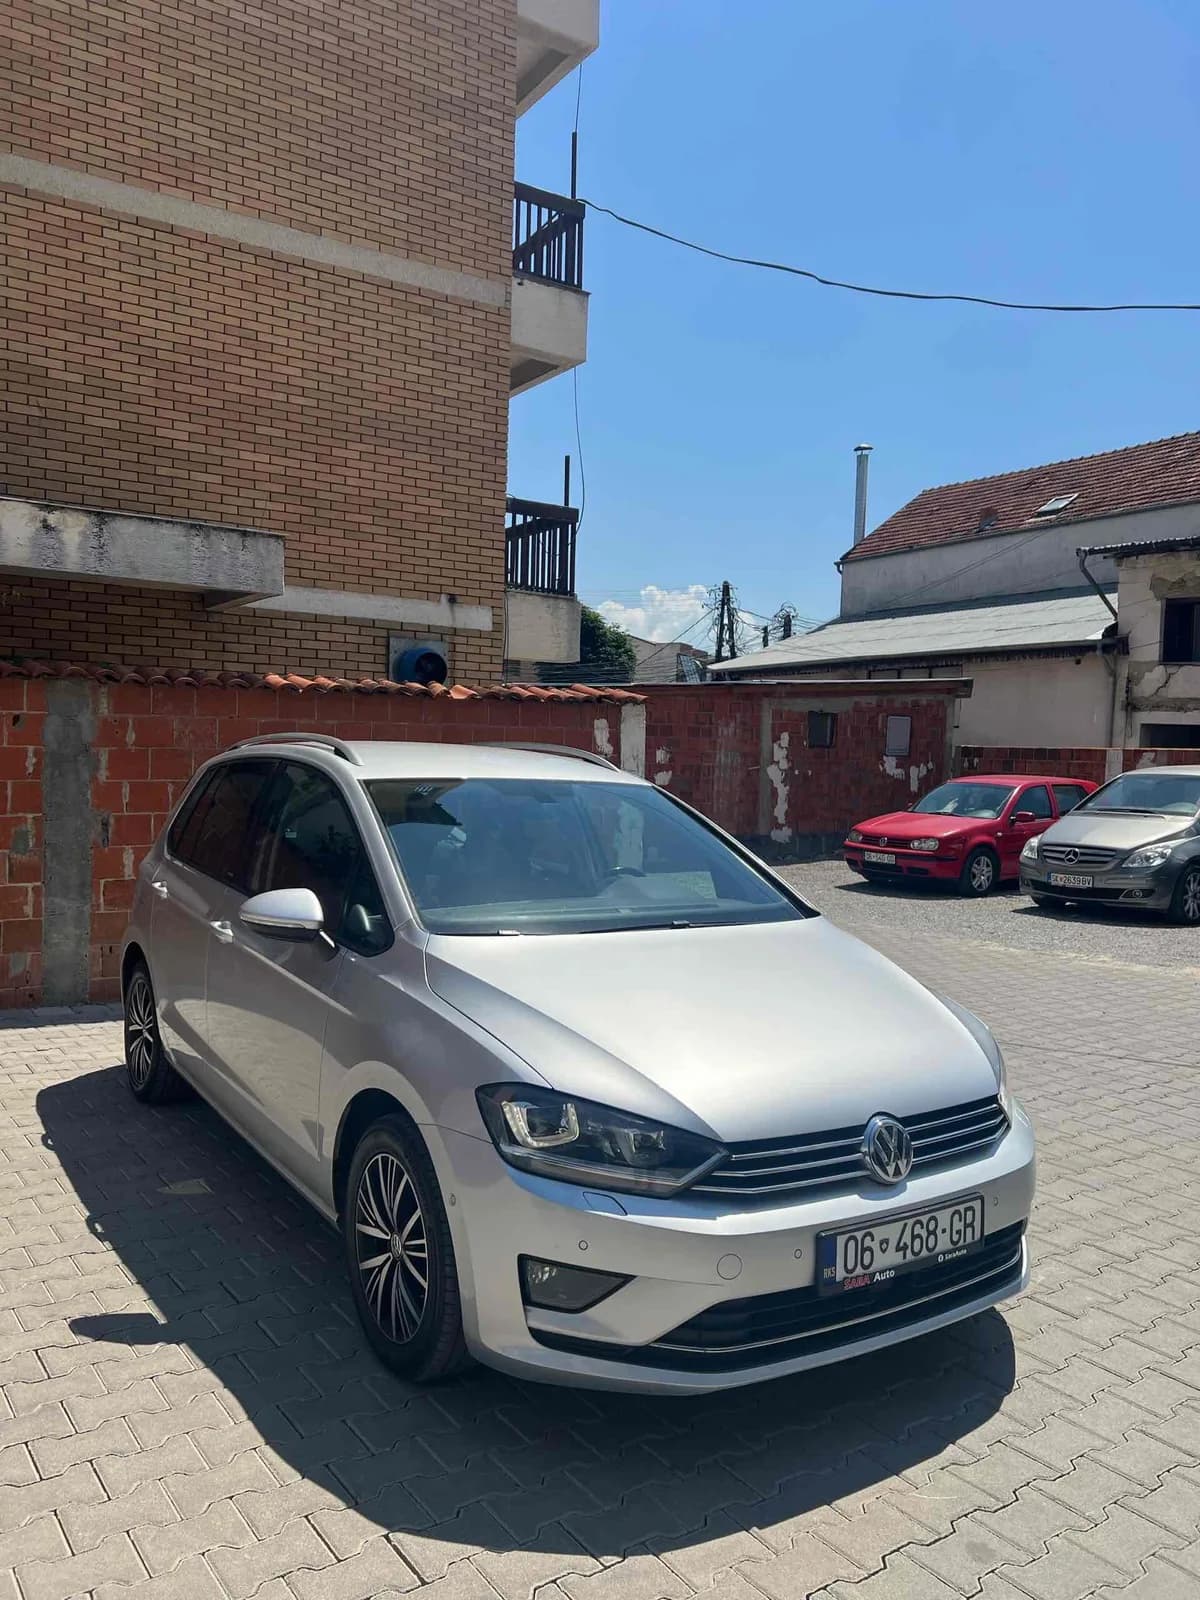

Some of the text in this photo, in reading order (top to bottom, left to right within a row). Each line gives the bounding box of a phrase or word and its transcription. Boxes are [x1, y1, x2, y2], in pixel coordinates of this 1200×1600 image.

[843, 1231, 875, 1275] 06
[823, 1266, 836, 1279] RKS
[873, 1269, 896, 1282] Auto
